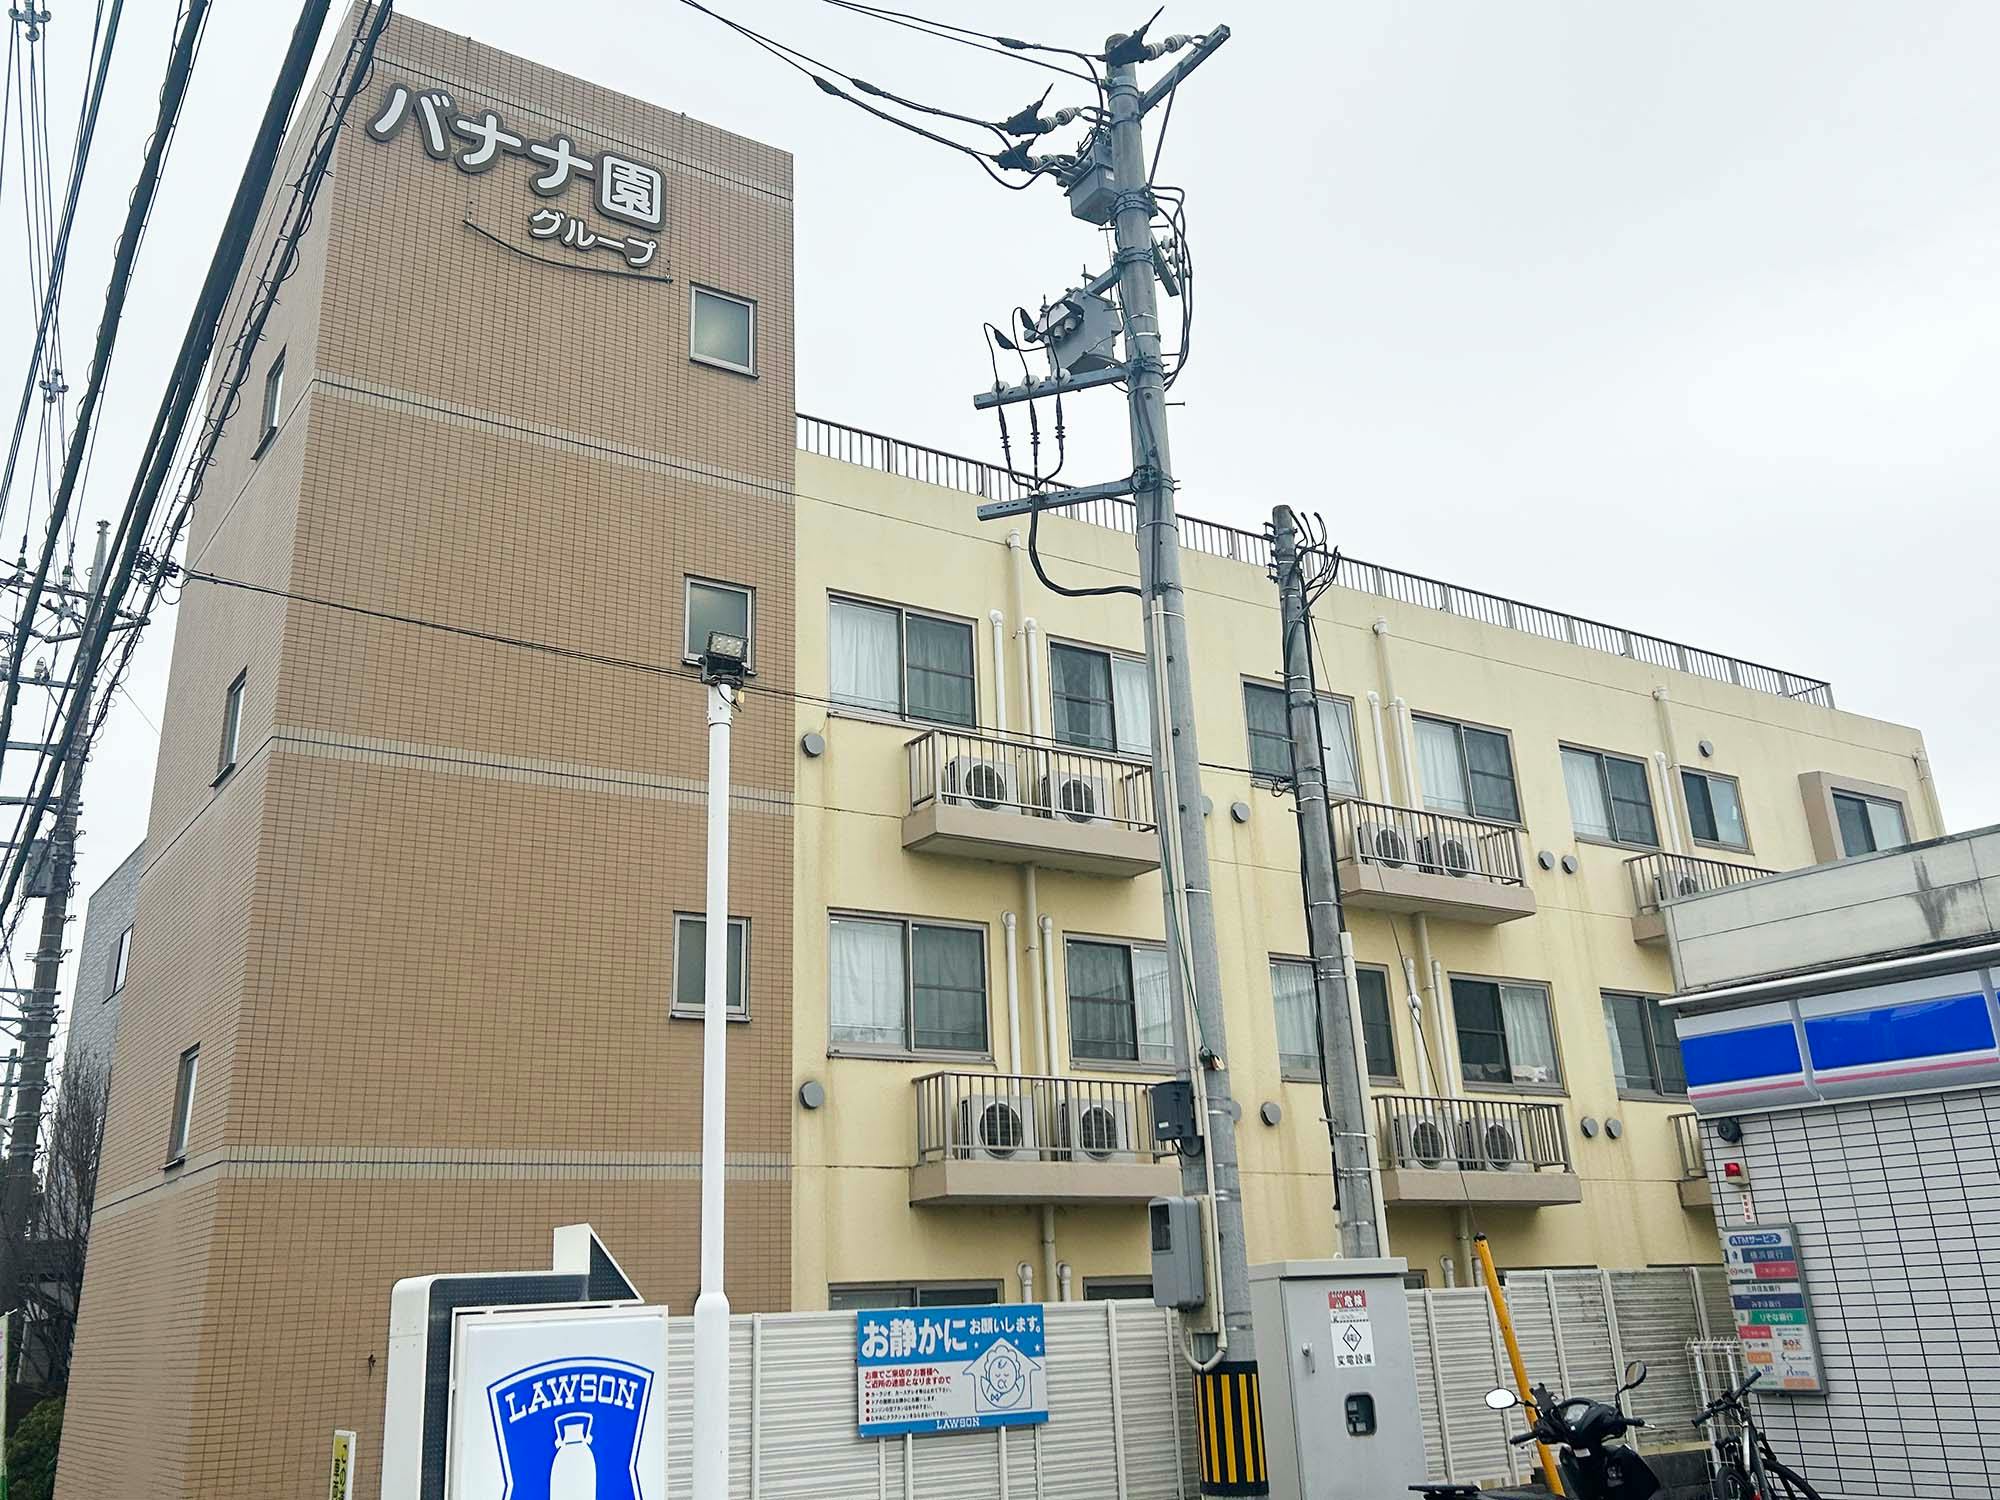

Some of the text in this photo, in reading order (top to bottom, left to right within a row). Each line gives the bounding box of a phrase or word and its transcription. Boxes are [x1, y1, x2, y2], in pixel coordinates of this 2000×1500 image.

[371, 86, 663, 226] バナナ園
[530, 208, 657, 265] グループ
[1730, 1234, 1779, 1246] ATMサービス
[861, 1315, 1041, 1359] お静かに お願いします。
[503, 1374, 639, 1425] LAWSON
[936, 1416, 980, 1430] LAWSON
